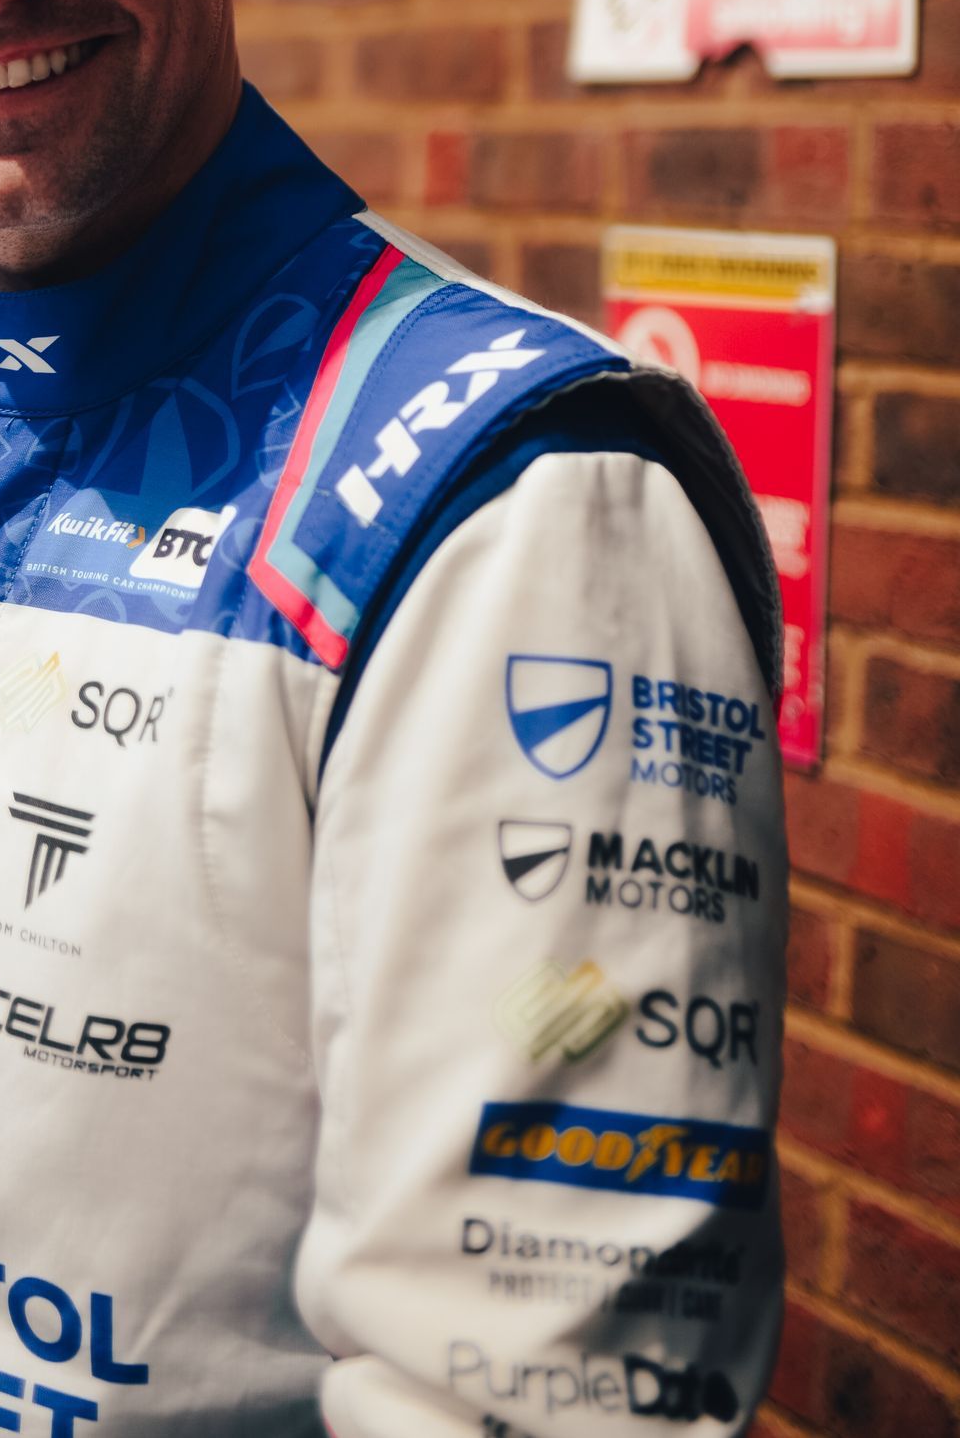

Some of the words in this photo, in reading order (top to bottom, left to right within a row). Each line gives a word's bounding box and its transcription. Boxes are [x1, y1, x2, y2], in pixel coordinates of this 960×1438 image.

[335, 328, 547, 529] HRX
[26, 563, 67, 576] BRITISH
[72, 569, 108, 582] TOURING
[113, 576, 135, 590] CAR
[70, 680, 166, 748] SQR
[632, 675, 766, 740] BRISTOL
[632, 717, 753, 775] STREET
[630, 757, 737, 806] MOTORS
[587, 832, 759, 901] MACKLIN
[586, 875, 726, 923] MOTORS
[20, 929, 82, 957] CHILTON
[636, 989, 759, 1070] SQR
[23, 1045, 159, 1081] MOTORSPORT
[482, 1121, 763, 1183] GOODYEAR
